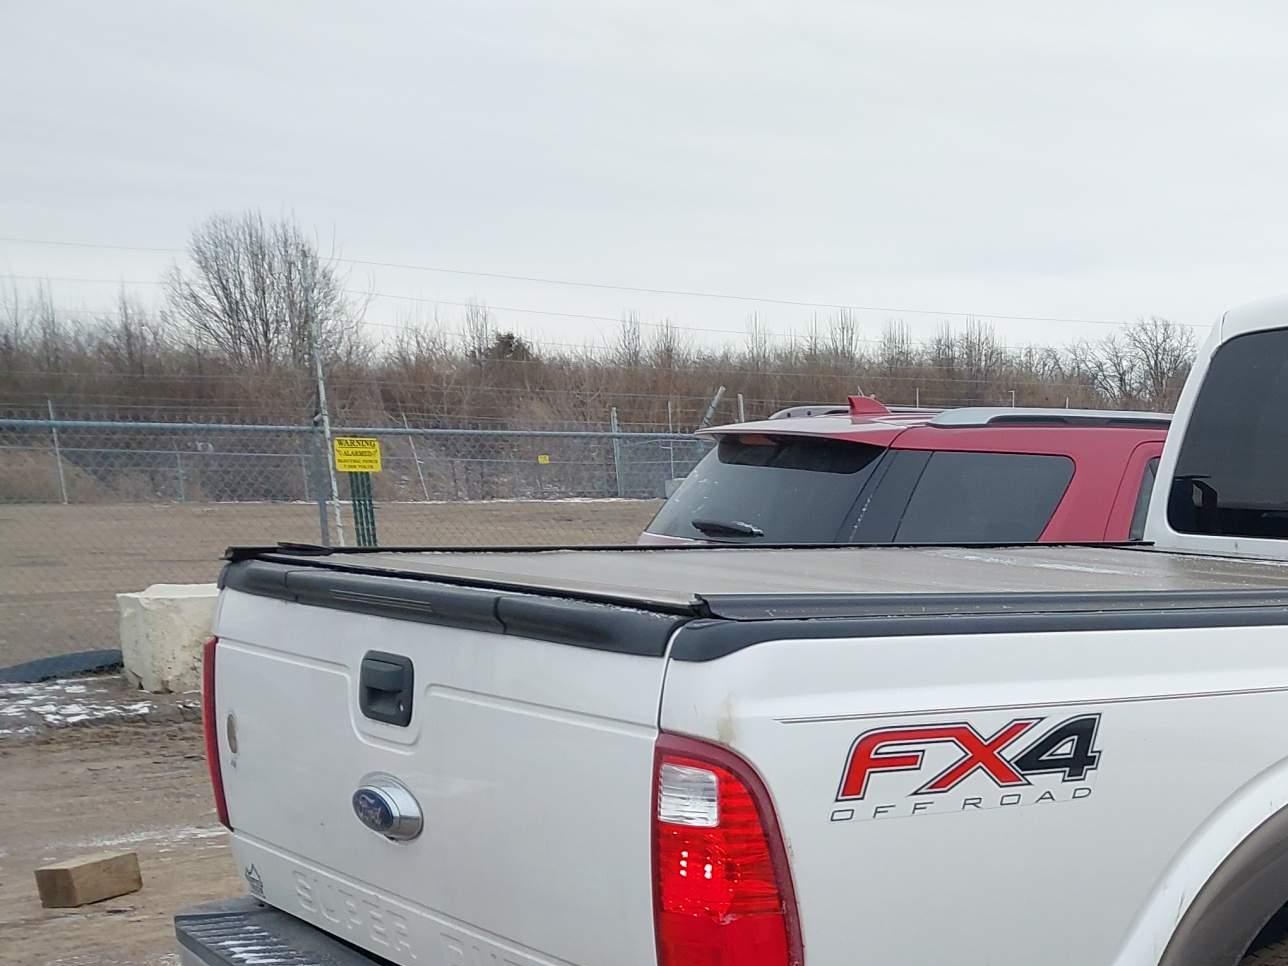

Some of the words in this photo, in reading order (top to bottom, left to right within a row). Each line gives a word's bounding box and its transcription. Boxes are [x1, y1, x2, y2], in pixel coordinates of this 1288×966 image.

[337, 440, 376, 448] WARNING
[834, 712, 1102, 802] FX4
[830, 804, 934, 822] OFF
[961, 787, 1093, 811] ROAD
[292, 869, 417, 960] SUPER
